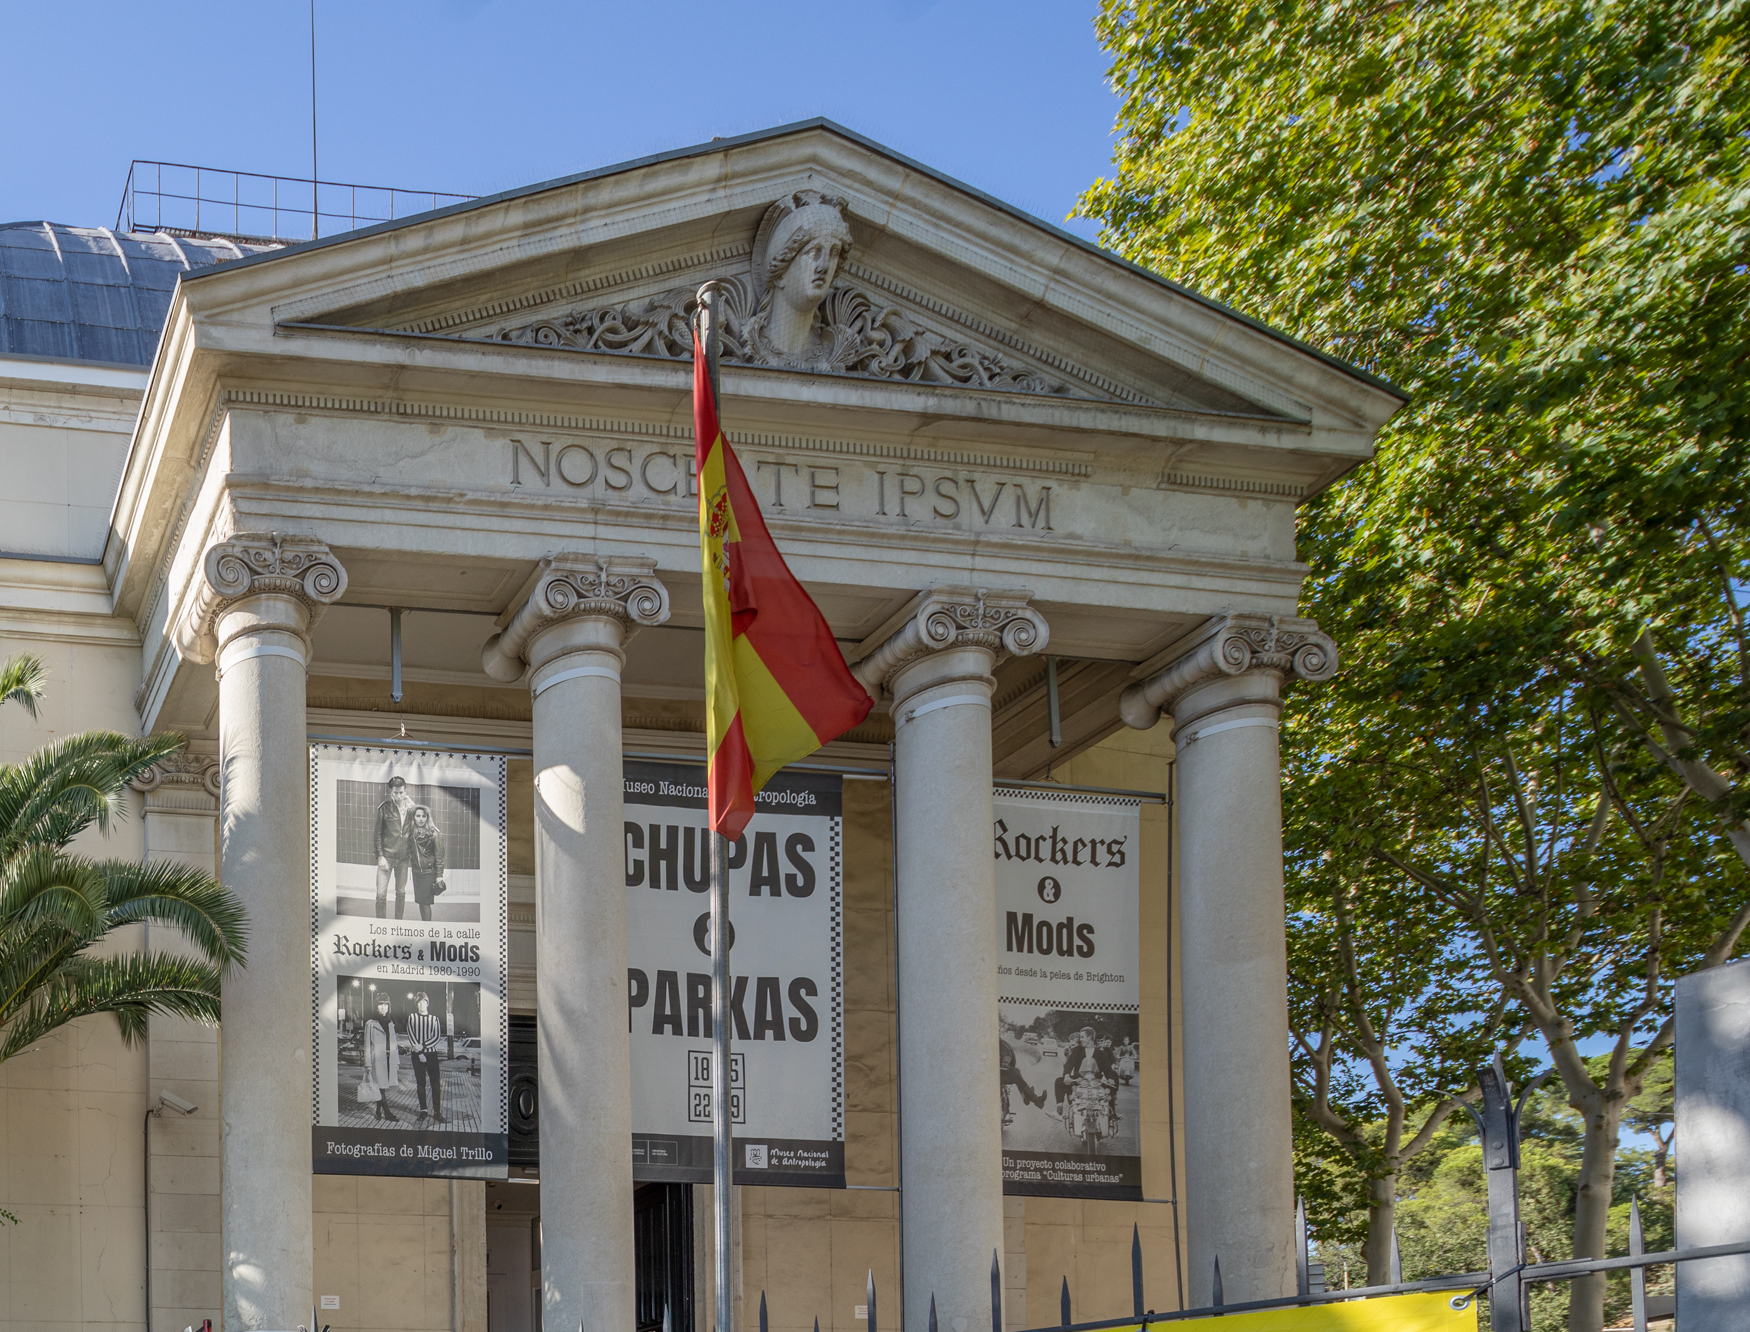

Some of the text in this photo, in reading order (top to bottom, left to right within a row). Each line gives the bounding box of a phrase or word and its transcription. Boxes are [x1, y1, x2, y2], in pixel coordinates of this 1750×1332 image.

[756, 460, 842, 513] TE
[874, 470, 1055, 532] IPSVM
[624, 821, 816, 898] CHUPAS
[370, 924, 480, 939] Los ritmos de la calle
[1006, 911, 1095, 958] Mods
[333, 934, 480, 963] Rockers & Mods
[377, 964, 480, 977] en Madrid 1980-1990
[1015, 967, 1037, 977] desde
[1040, 969, 1047, 978] la
[1049, 970, 1071, 980] pelea
[1074, 971, 1083, 980] de
[1086, 972, 1124, 984] Brighton
[628, 968, 819, 1042] PARKAS
[327, 1142, 493, 1161] Fotografías de Miguel Trillo
[771, 1148, 828, 1158] Museo Nacional
[771, 1157, 779, 1165] de
[1003, 1157, 1106, 1171] Un proyecto colaborativo
